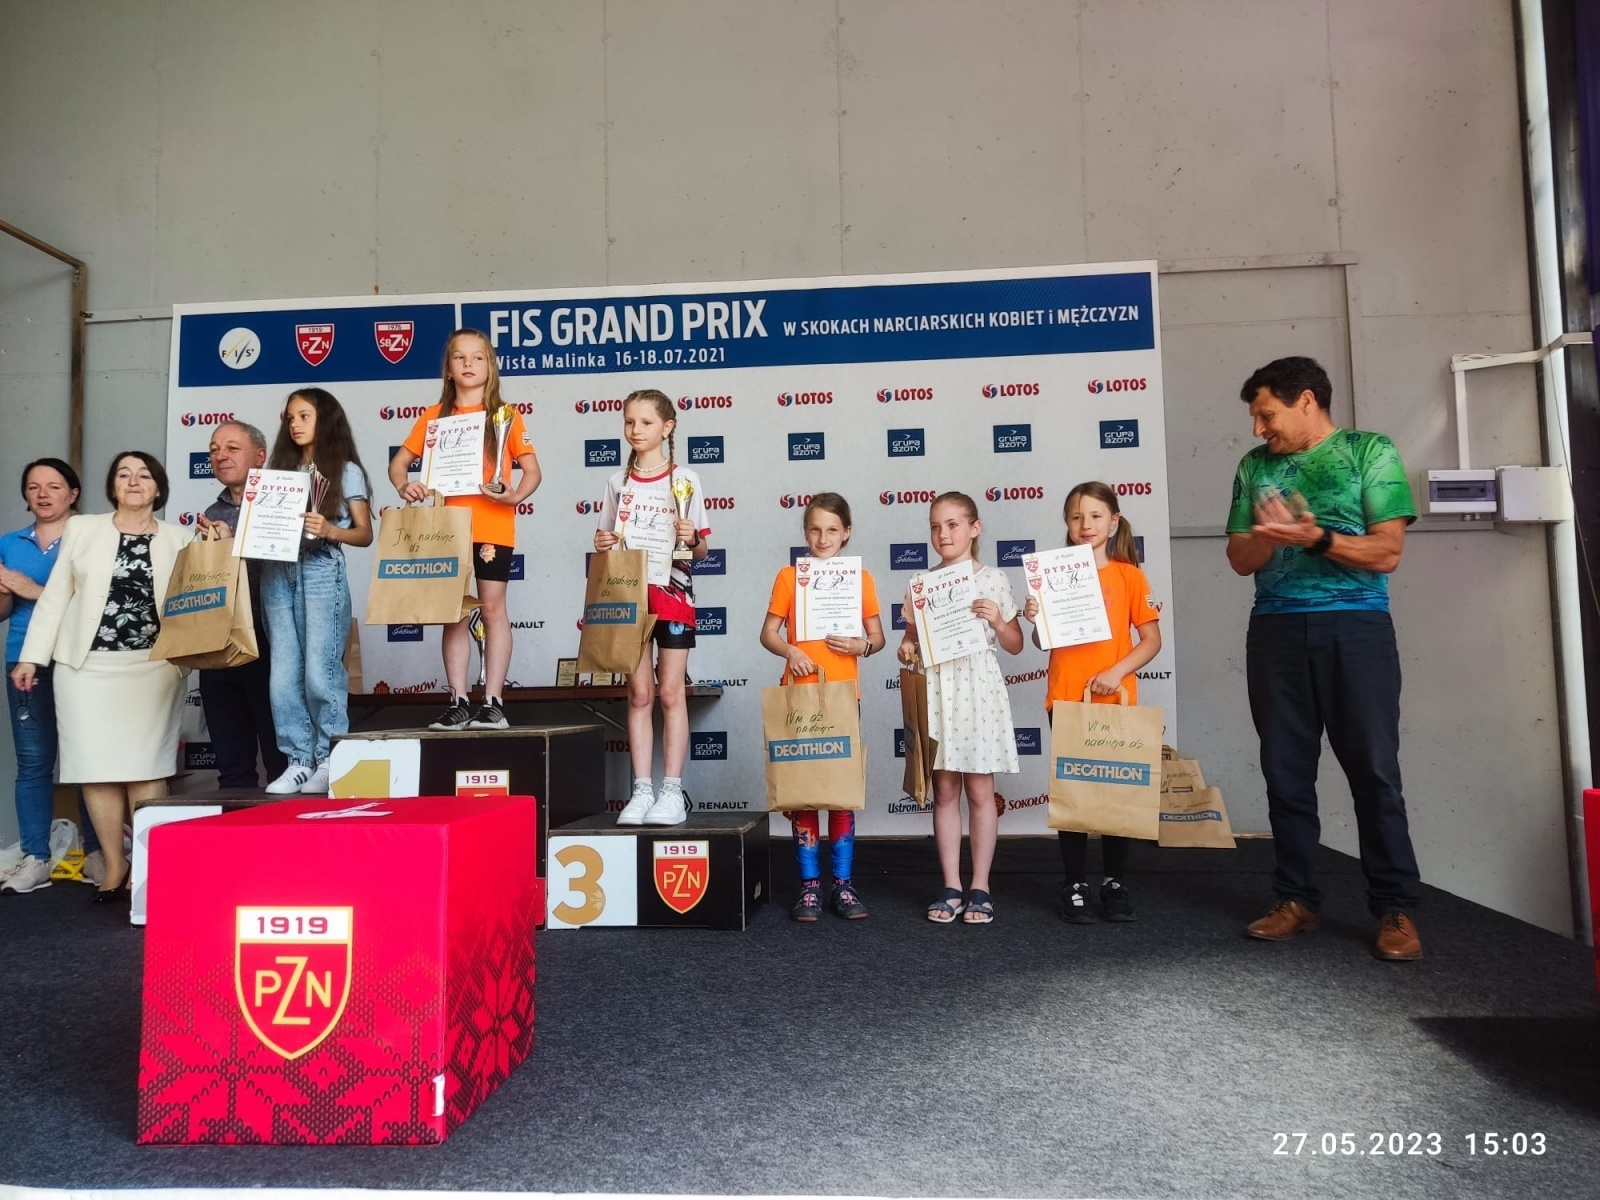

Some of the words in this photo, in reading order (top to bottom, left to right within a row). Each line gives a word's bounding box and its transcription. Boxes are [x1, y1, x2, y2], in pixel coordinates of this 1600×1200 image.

[489, 308, 543, 348] FIS
[550, 303, 674, 346] GRAND
[682, 299, 769, 341] PRIX
[783, 321, 796, 336] W
[800, 318, 870, 336] SKOKACH
[873, 313, 985, 333] NARCIARSKICH
[988, 310, 1045, 328] KOBIET
[1057, 305, 1140, 326] MĘŻCZYZN
[302, 336, 330, 355] PZN
[542, 351, 606, 369] Malinka
[615, 346, 726, 366] 16-18.07.2021
[1000, 382, 1041, 397] LOTOS
[1106, 377, 1148, 393] LOTOS
[695, 395, 733, 409] LOTOS
[794, 391, 833, 405] LOTOS
[894, 387, 934, 402] LOTOS
[440, 424, 481, 436] DYPLOM
[261, 484, 305, 494] DYPLOM
[1003, 486, 1044, 500] LOTOS
[897, 490, 936, 504] LOTOS
[634, 503, 676, 515] DYPLOM
[385, 561, 453, 575] DECATHLON
[1043, 561, 1091, 576] DYPLOM
[927, 574, 970, 594] DYPLOM
[167, 592, 221, 613] DECATHLON
[510, 621, 546, 629] NAULT
[774, 741, 845, 758] DECATHLON
[1063, 762, 1144, 781] DECATHLON
[464, 774, 499, 785] 1919
[698, 801, 749, 810] RENAULT
[1162, 811, 1218, 821] DECATHLON
[663, 845, 698, 855] 1919
[551, 844, 606, 925] 3
[663, 864, 701, 898] PZN
[256, 916, 329, 935] 1919
[254, 956, 333, 1026] PZN
